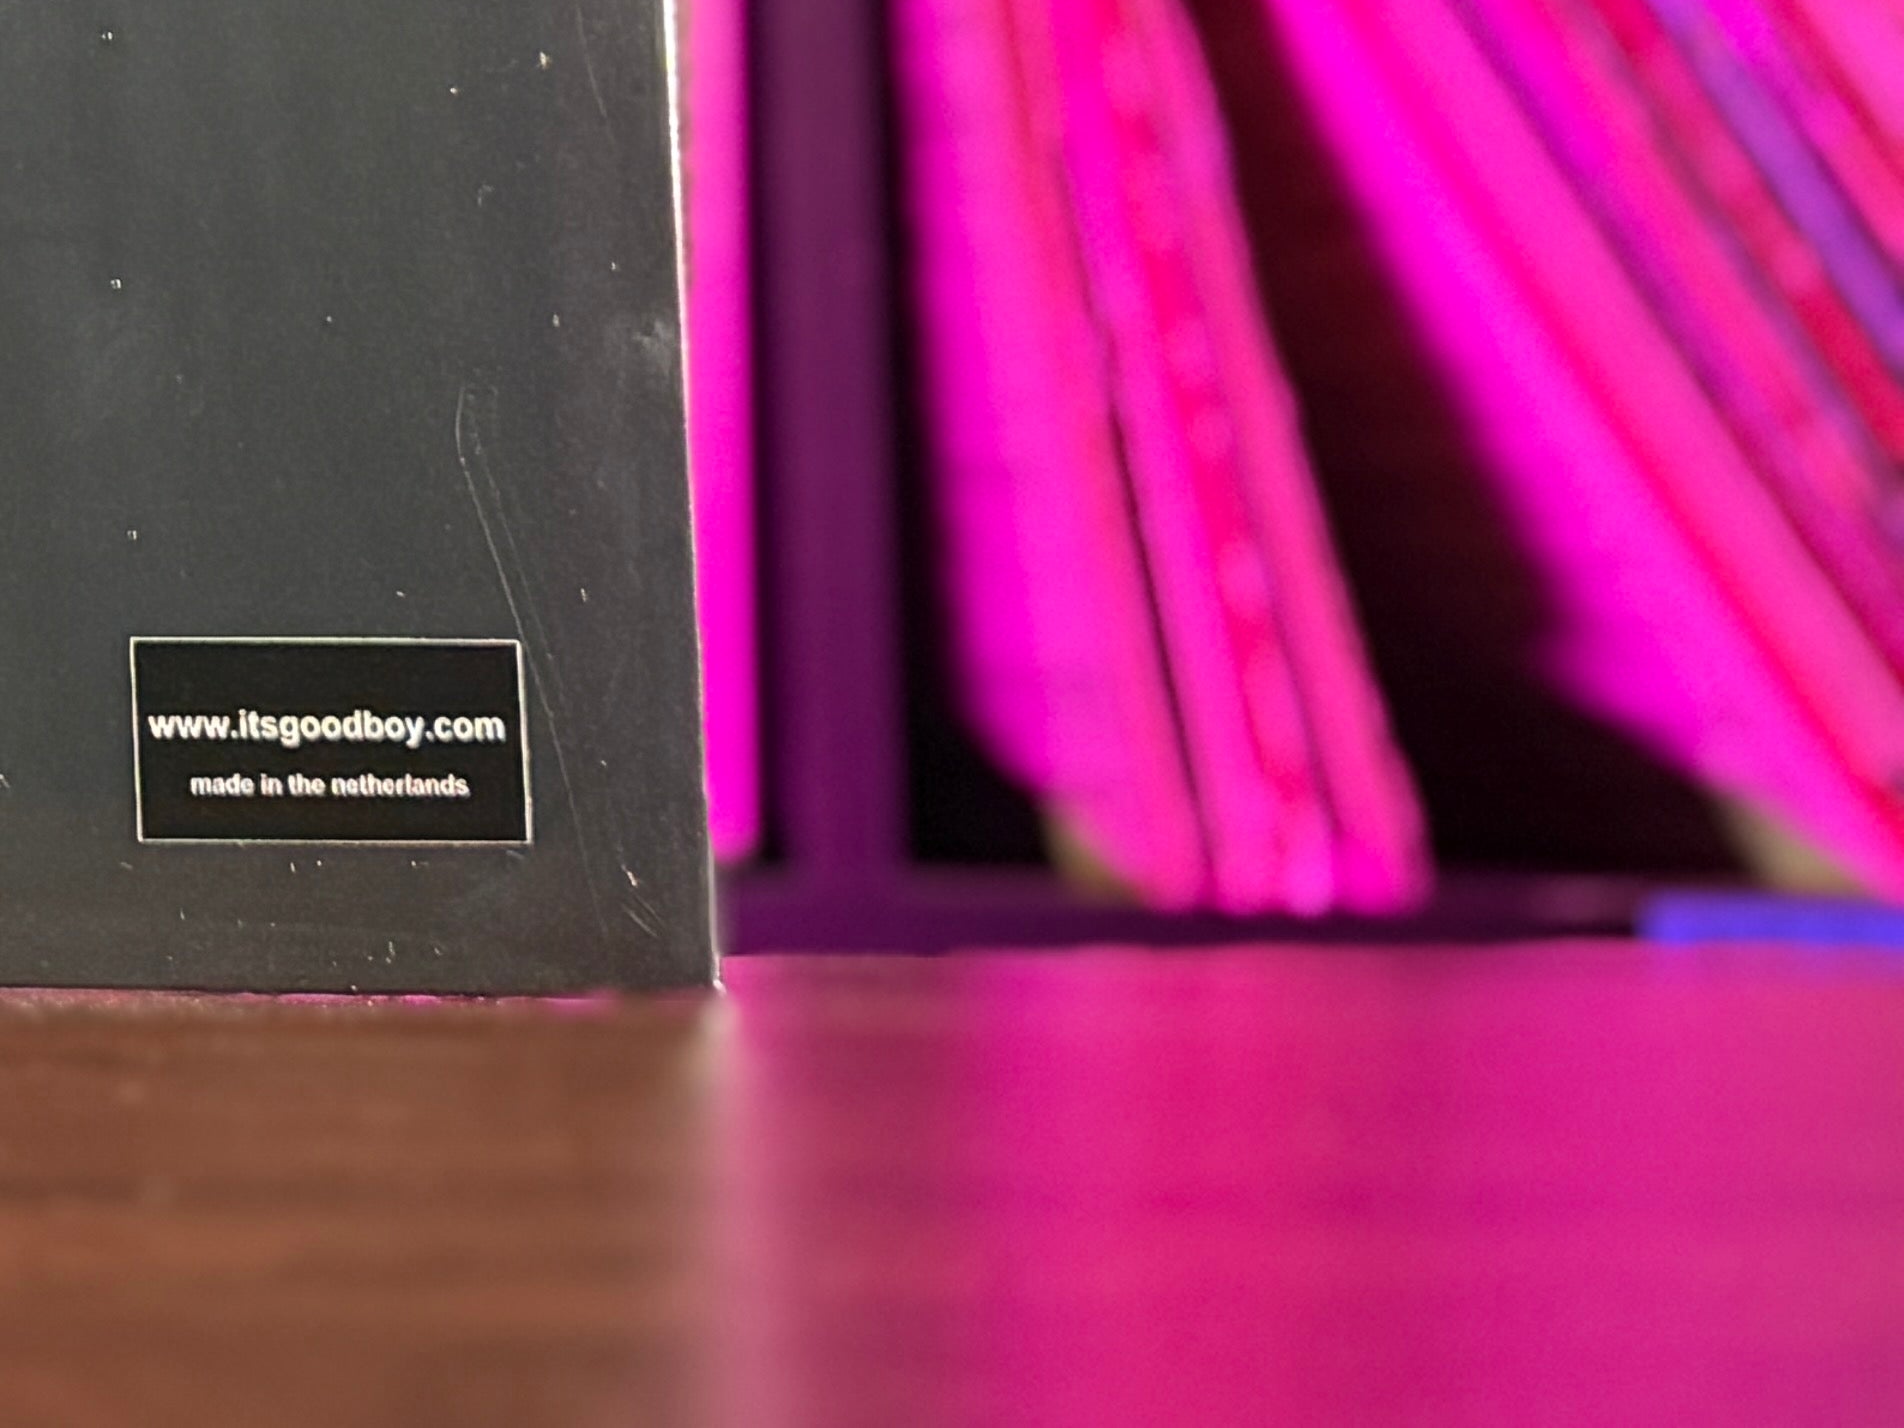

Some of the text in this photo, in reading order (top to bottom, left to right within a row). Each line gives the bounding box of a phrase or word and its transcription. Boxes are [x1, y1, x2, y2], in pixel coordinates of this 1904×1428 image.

[147, 708, 506, 749] www.itsgoodboy.com
[189, 772, 471, 797] made in the netherlands
